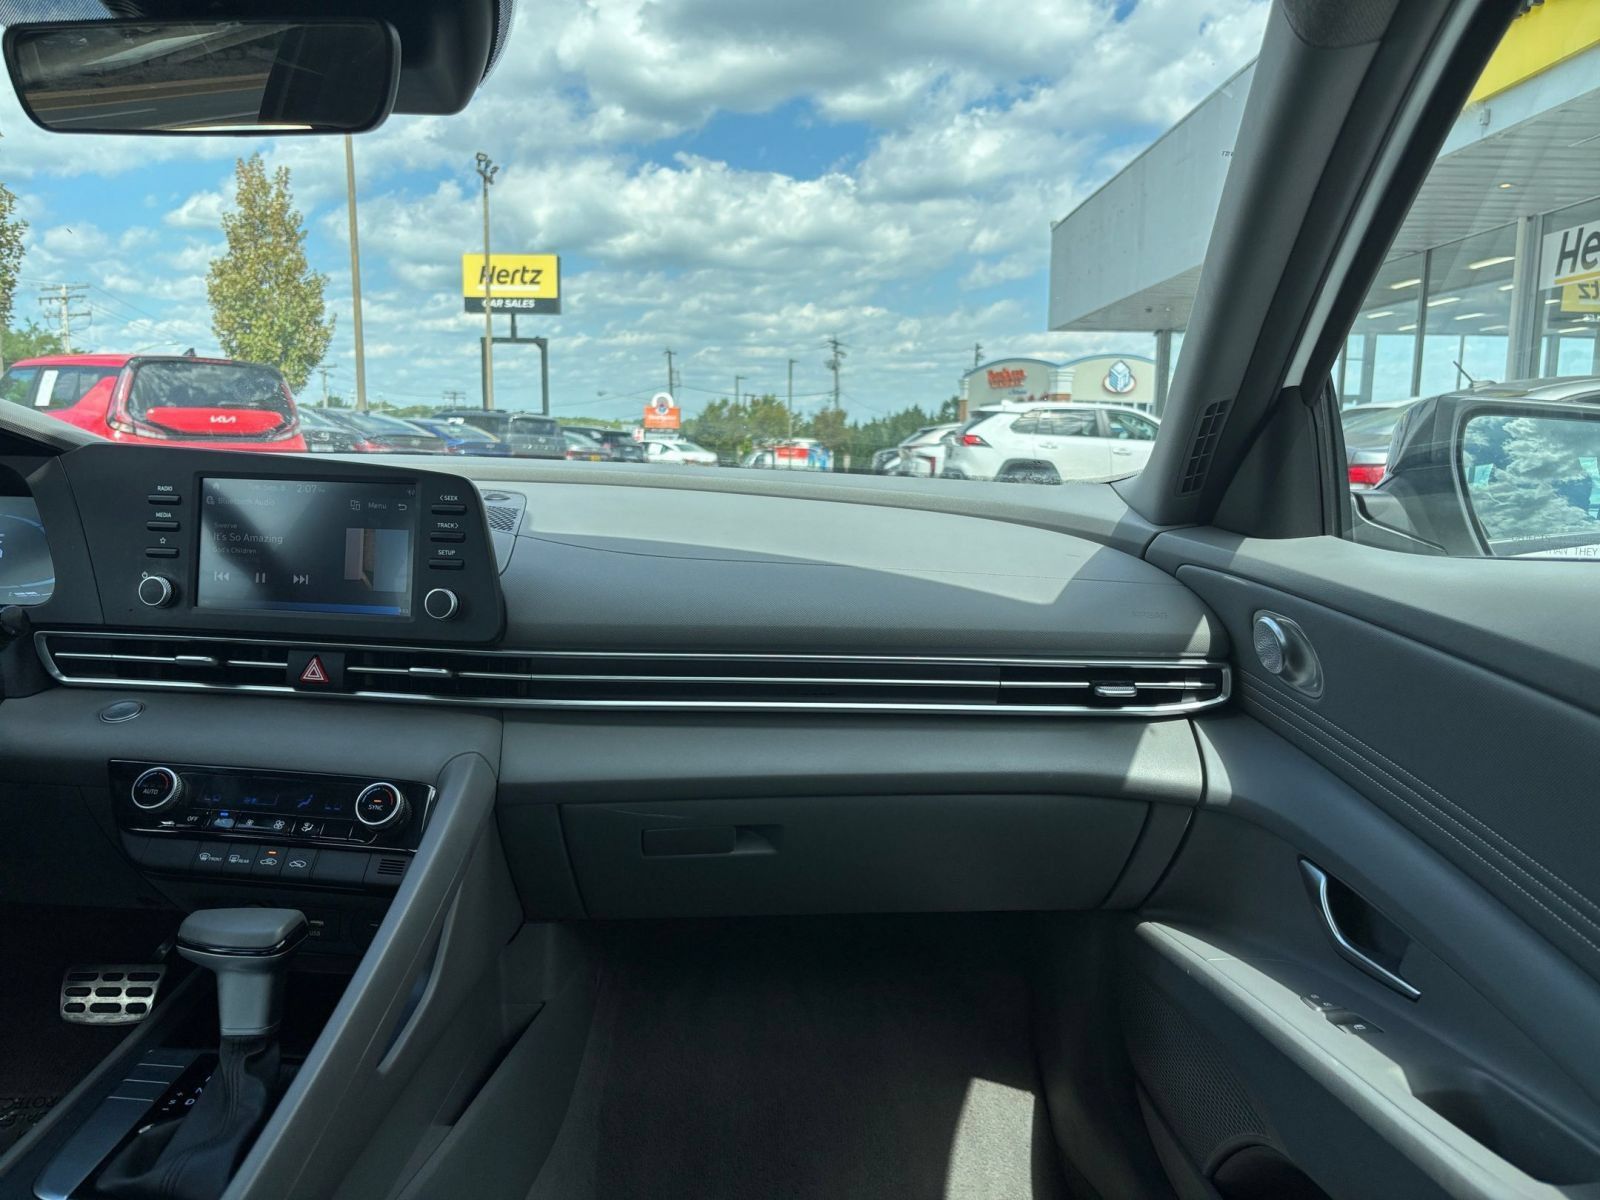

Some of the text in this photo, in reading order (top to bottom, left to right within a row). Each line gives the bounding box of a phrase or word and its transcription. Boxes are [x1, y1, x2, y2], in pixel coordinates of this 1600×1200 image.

[479, 265, 543, 285] Hertz
[482, 298, 535, 308] CAR SALES
[368, 501, 387, 509] Menu
[230, 533, 242, 541] So
[243, 533, 283, 544] Amazing
[1575, 547, 1598, 556] THEY
